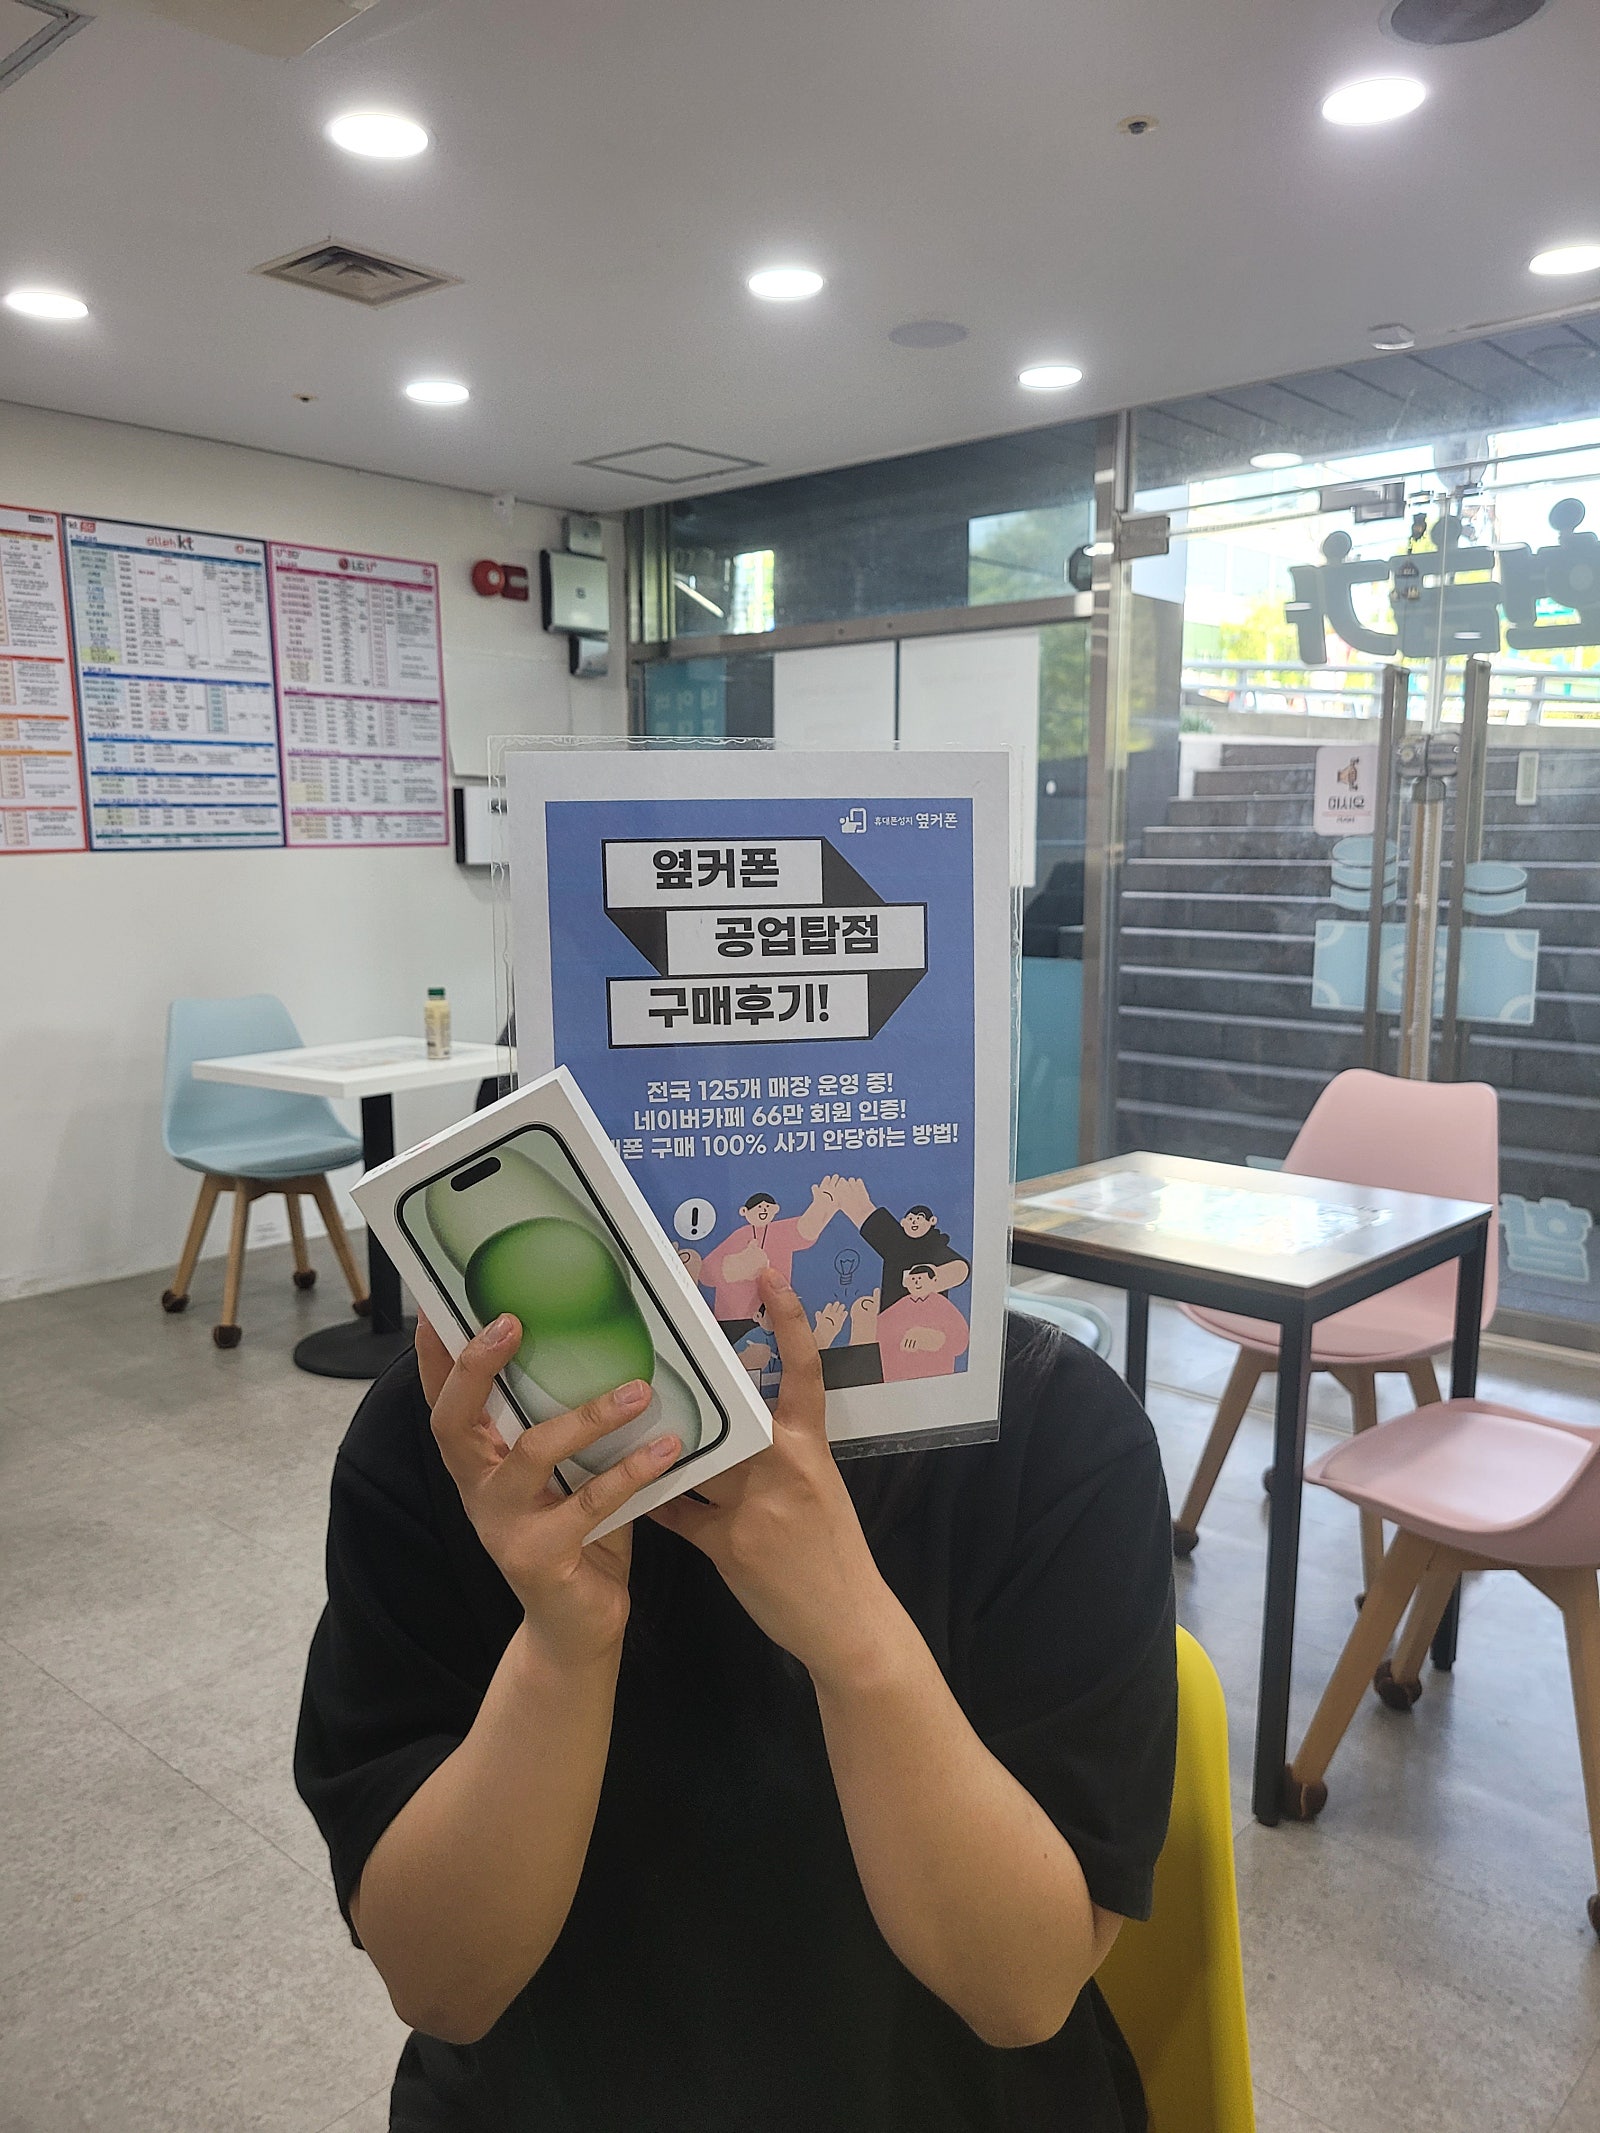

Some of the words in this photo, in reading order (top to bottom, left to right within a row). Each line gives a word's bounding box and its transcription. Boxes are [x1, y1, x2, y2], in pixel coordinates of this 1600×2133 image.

[177, 535, 195, 552] kt
[874, 815, 913, 827] 휴대폰성지
[916, 812, 958, 829] 옆커폰
[652, 847, 780, 890] 옆커폰
[714, 914, 880, 958] 공업탑점
[647, 983, 830, 1029] 구매후기!
[647, 1079, 691, 1103] 전국
[698, 1077, 761, 1101] 125개
[768, 1075, 812, 1098] 매장
[817, 1074, 860, 1096] 운영
[866, 1072, 894, 1095] 중!
[633, 1108, 745, 1132] 네이버카페
[751, 1104, 804, 1128] 66만
[809, 1102, 852, 1125] 회원
[858, 1099, 907, 1122] 인증!
[651, 1136, 695, 1160] 구매
[701, 1133, 767, 1156] 100%
[774, 1130, 817, 1153] 사기
[822, 1127, 906, 1152] 안당하는
[912, 1123, 960, 1145] 방법!
